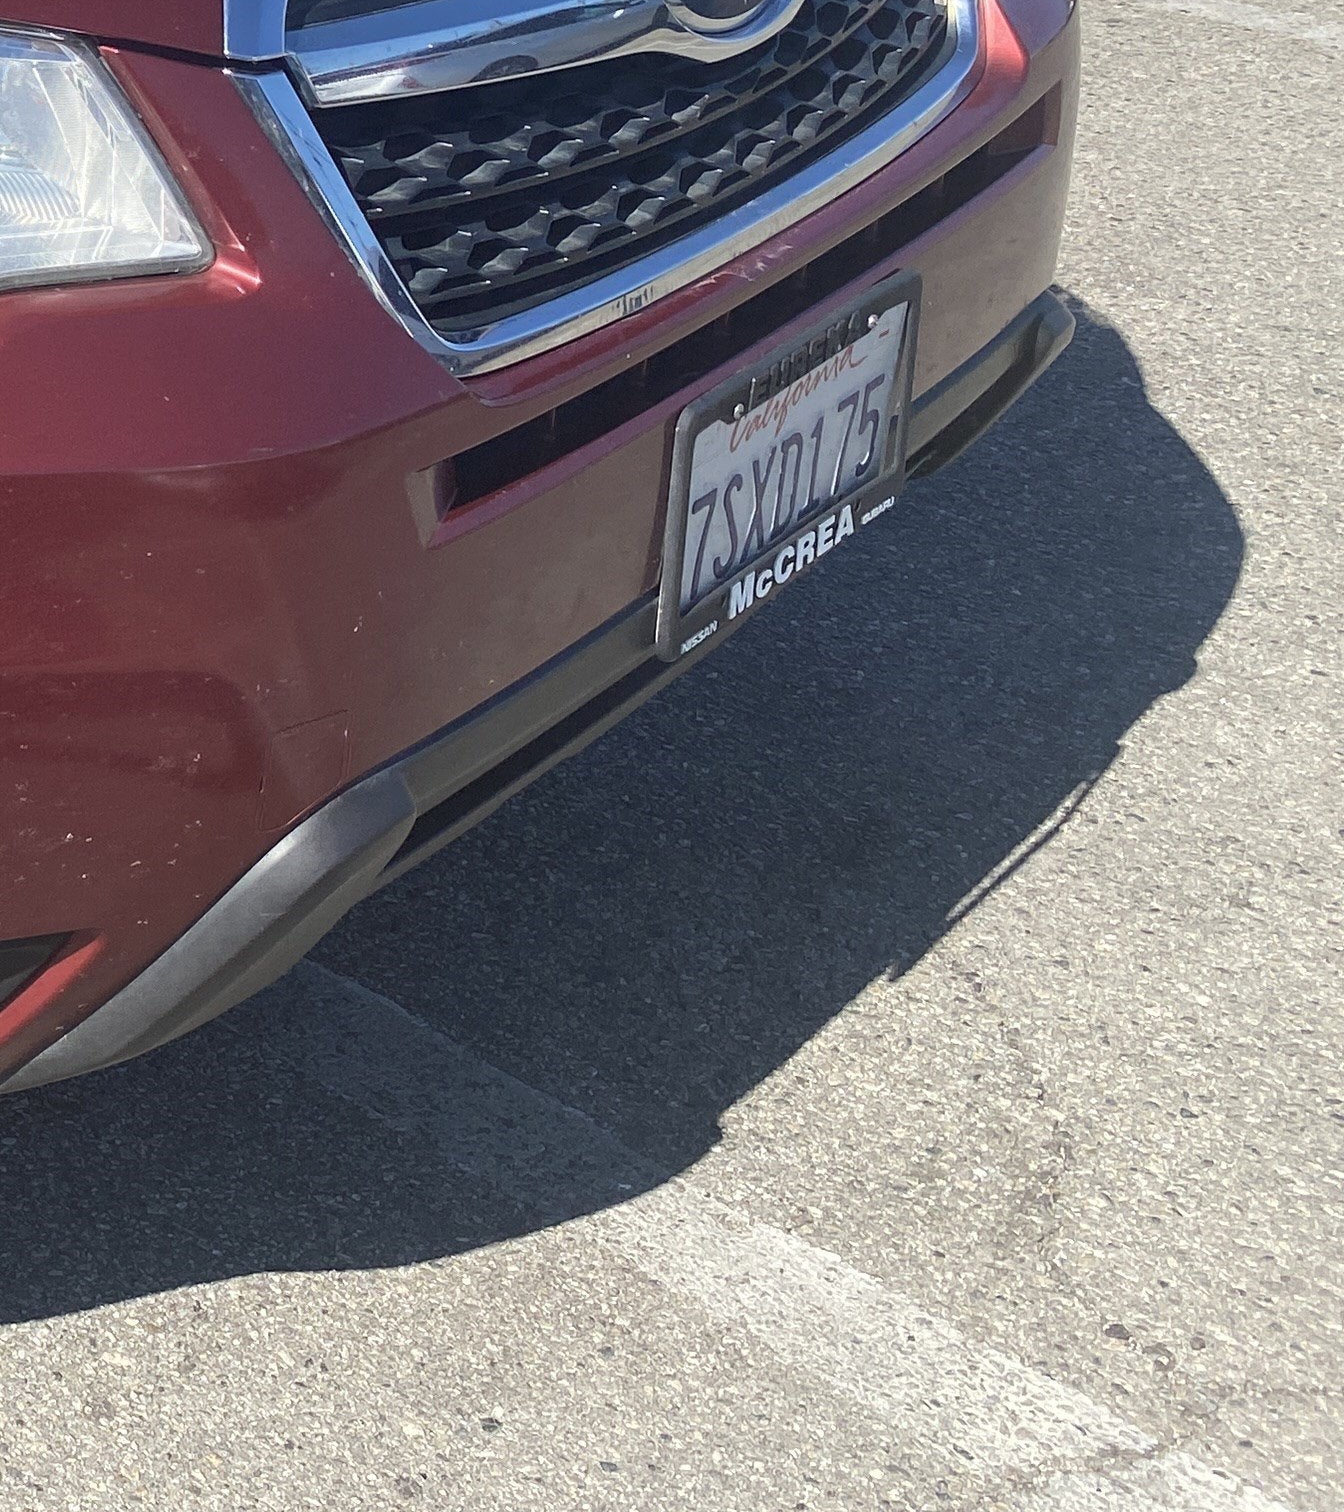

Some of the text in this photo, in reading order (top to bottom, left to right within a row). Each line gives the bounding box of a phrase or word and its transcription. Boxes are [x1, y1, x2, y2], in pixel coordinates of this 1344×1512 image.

[729, 344, 868, 453] California
[690, 373, 886, 602] 7SXD175
[728, 504, 855, 620] McCREA
[680, 620, 718, 655] NISSAN
